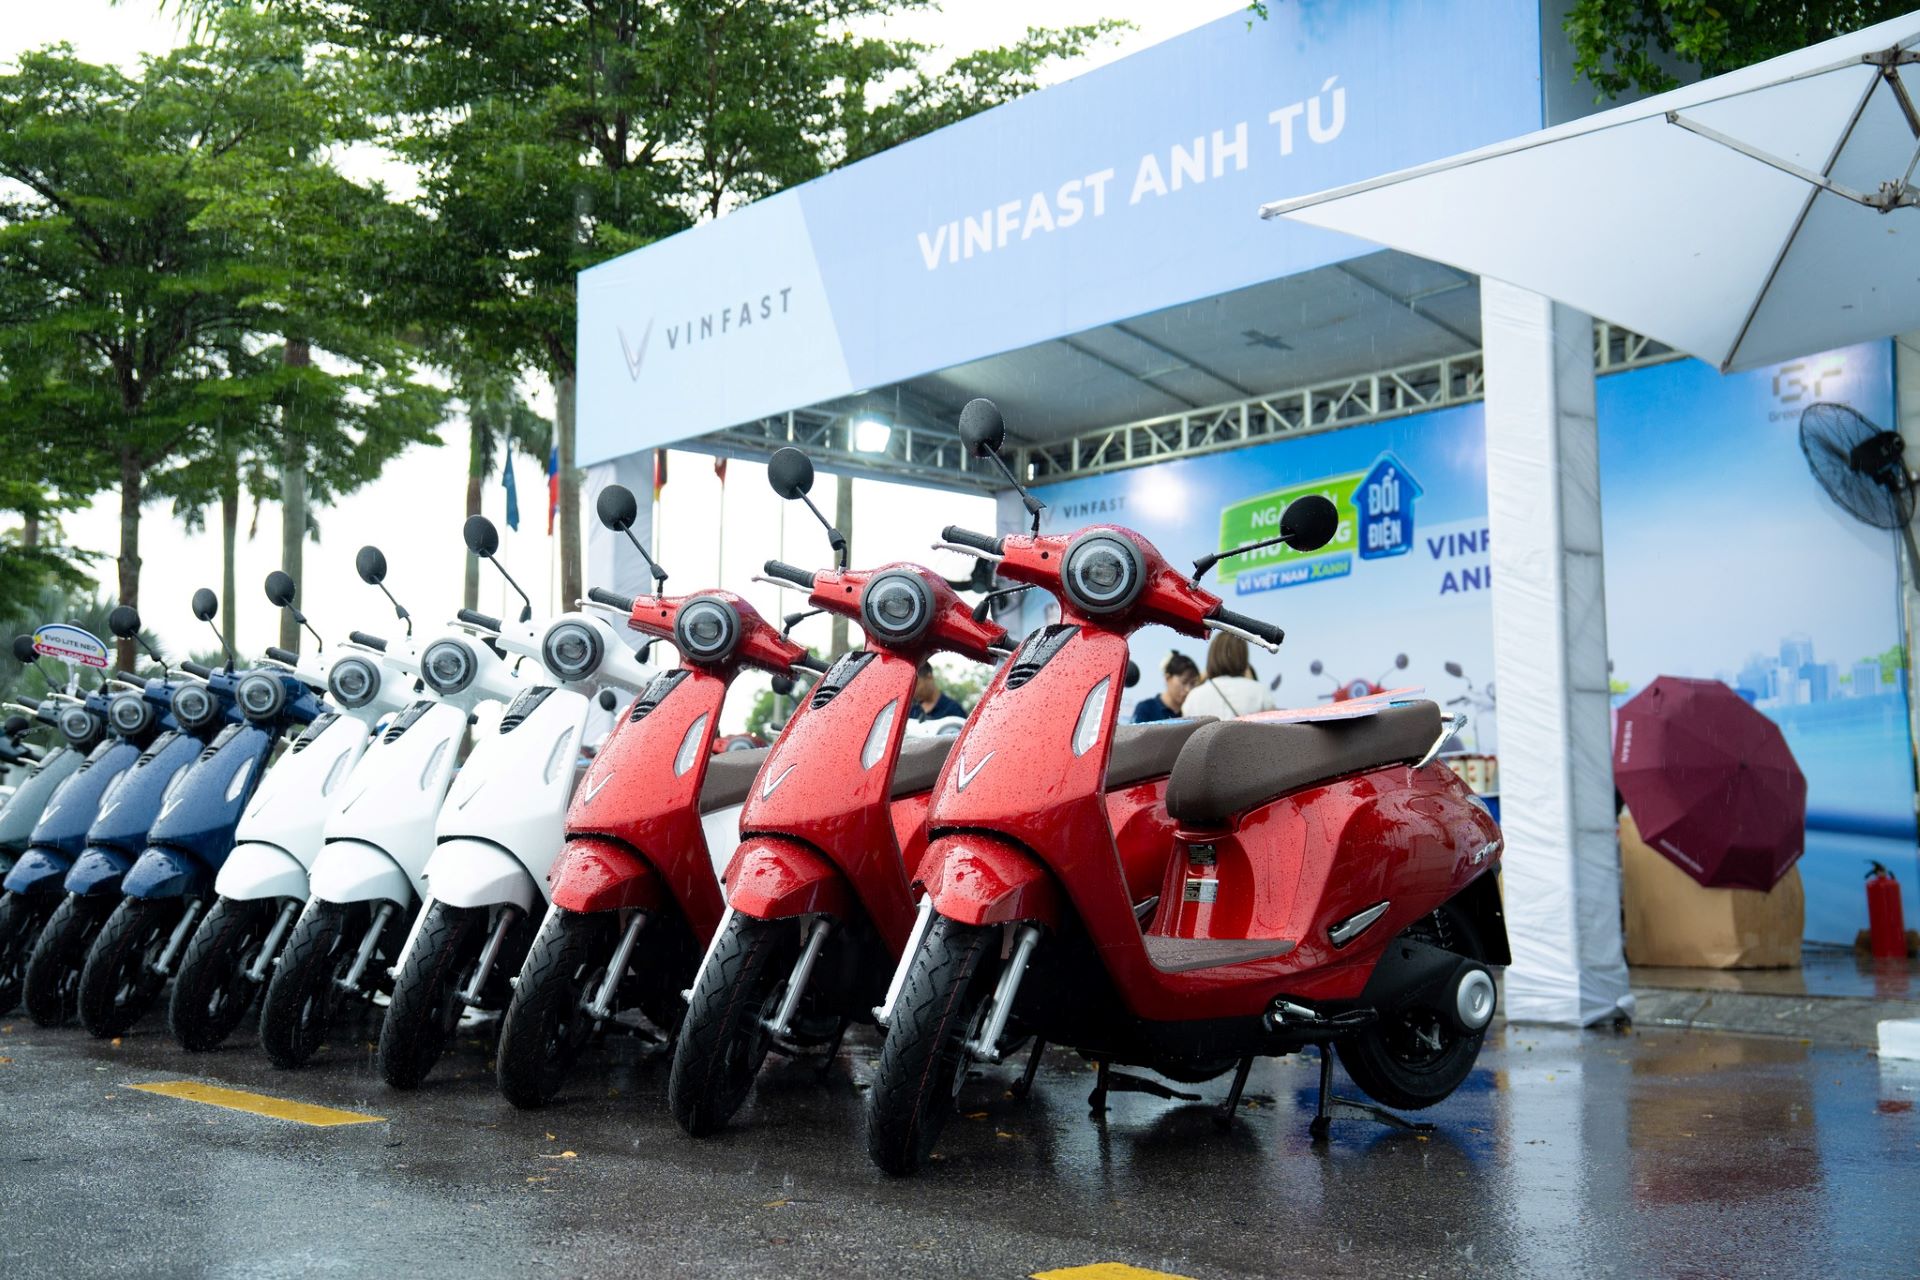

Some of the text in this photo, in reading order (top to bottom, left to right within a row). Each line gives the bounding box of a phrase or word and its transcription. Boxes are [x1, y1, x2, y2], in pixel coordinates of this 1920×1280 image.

[918, 75, 1346, 270] VINFAST ANH TÚ
[667, 287, 792, 350] VINFAST
[1063, 497, 1125, 518] VINFAST
[1368, 467, 1399, 516] ĐỔI
[1368, 516, 1402, 549] ĐIỆN
[1426, 528, 1490, 560] VINF
[1253, 570, 1279, 590] VIỆT
[1281, 567, 1309, 584] NAM
[44, 633, 97, 651] EVO LITE NEO
